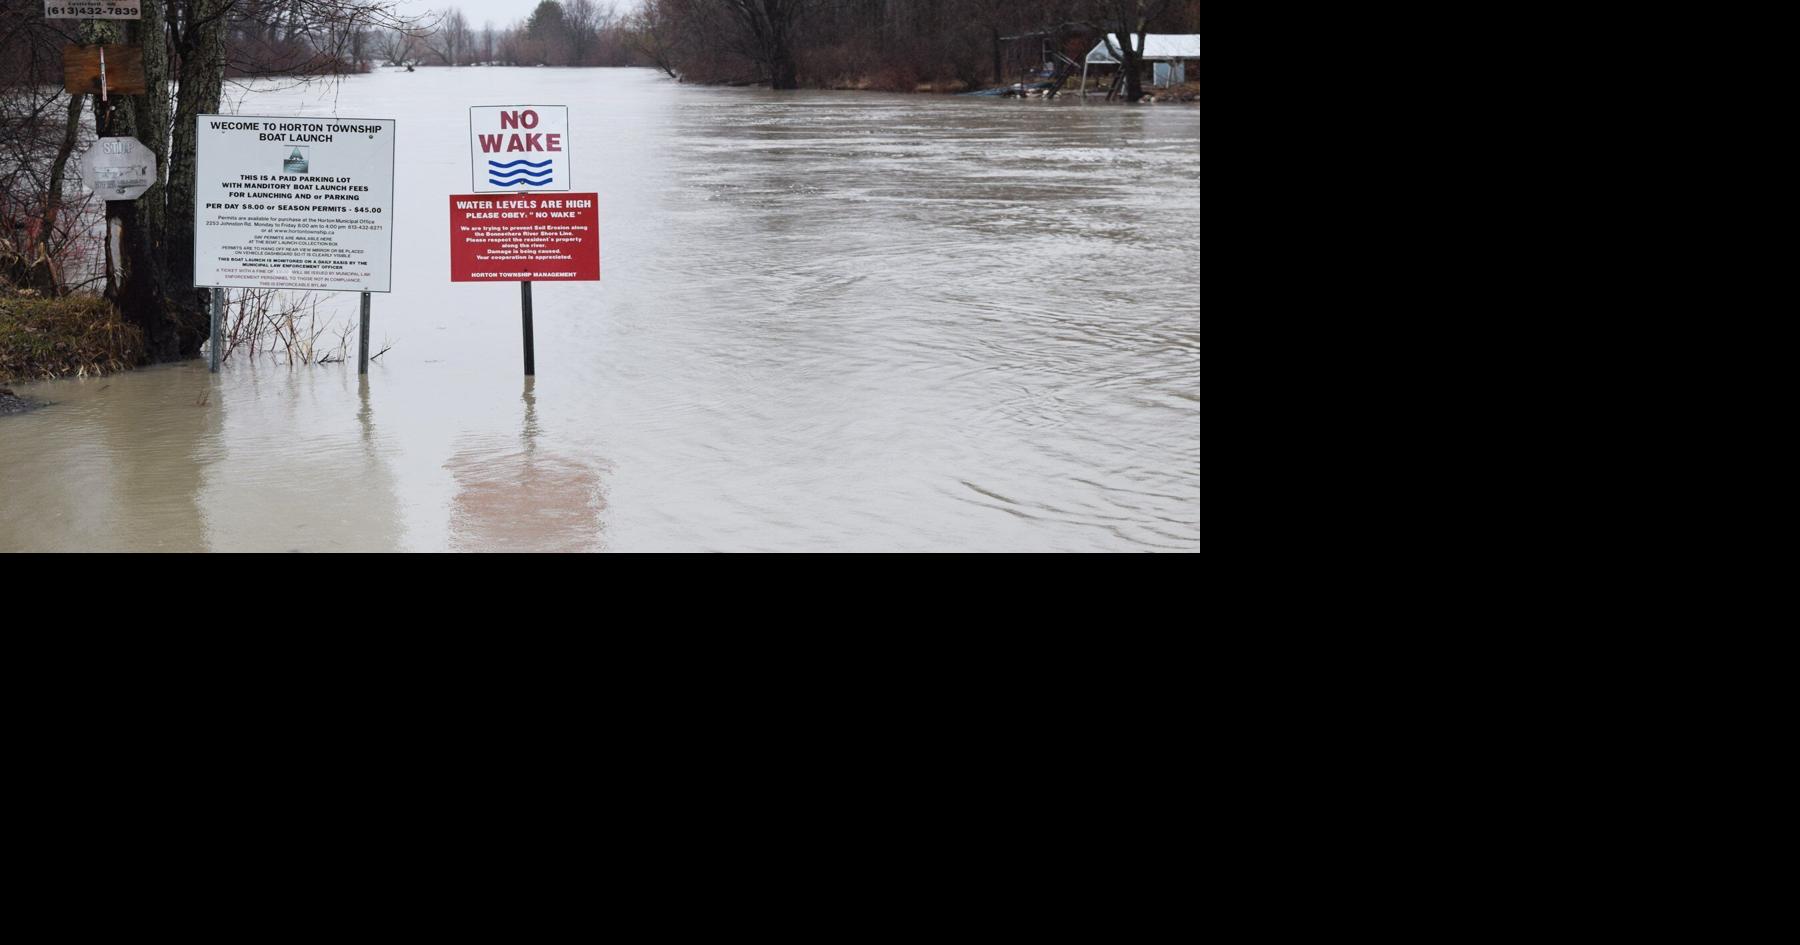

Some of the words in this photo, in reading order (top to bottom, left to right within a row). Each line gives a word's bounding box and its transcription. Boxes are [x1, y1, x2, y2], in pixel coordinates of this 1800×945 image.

[48, 7, 138, 16] (613)432-7839
[500, 110, 539, 129] NO
[210, 122, 259, 131] WECOME
[264, 123, 276, 131] TO
[279, 123, 323, 132] HORTON
[328, 124, 382, 133] TOWNSHIP
[259, 133, 285, 142] BOAT
[290, 134, 332, 142] LAUNCH
[478, 133, 562, 153] WAKE
[457, 200, 493, 209] WATER
[496, 200, 537, 209] LEVELS
[541, 200, 562, 208] ARE
[566, 200, 591, 208] HIGH
